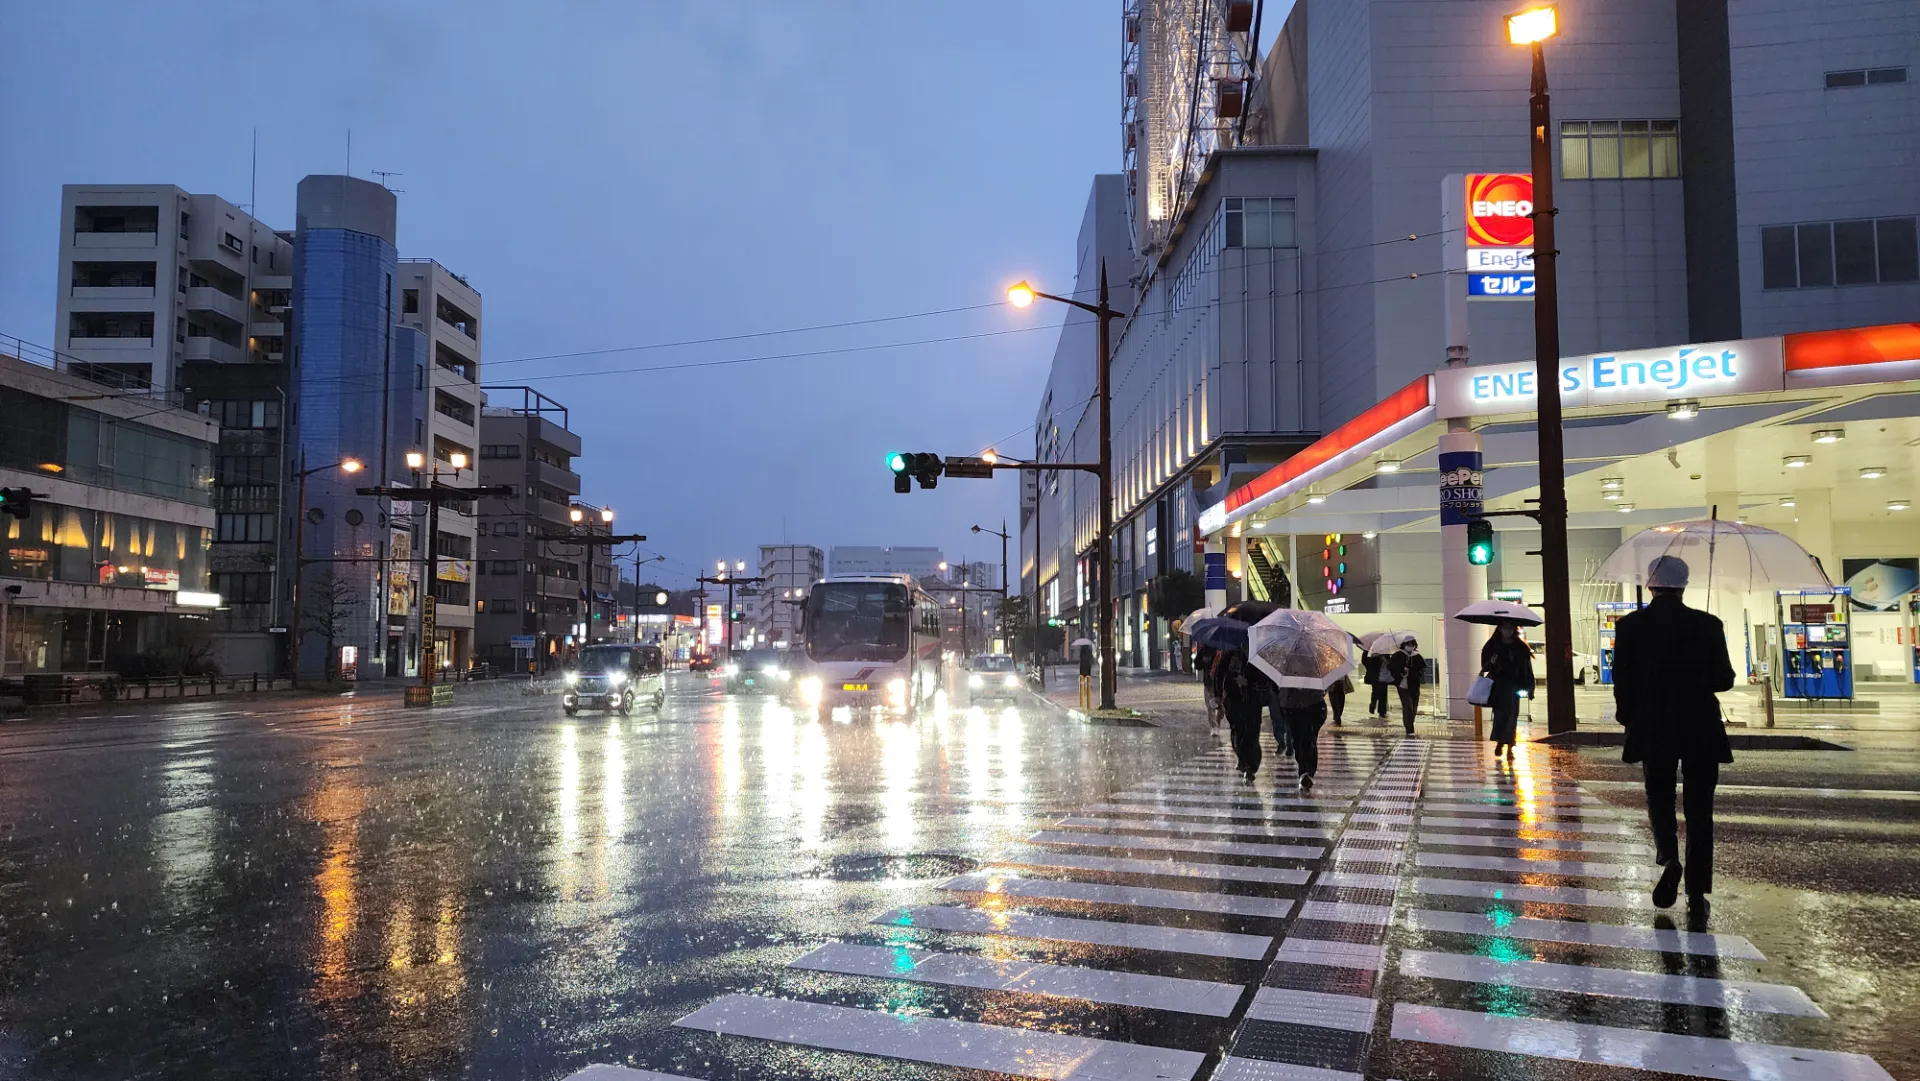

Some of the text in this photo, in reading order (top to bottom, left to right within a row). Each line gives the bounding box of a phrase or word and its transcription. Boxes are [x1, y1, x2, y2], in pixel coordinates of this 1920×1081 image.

[1472, 200, 1533, 217] ENEO
[1480, 250, 1533, 269] Eneje
[1480, 276, 1535, 294] セルフ
[1473, 348, 1736, 399] ENES Enejet
[1440, 469, 1483, 486] eePer
